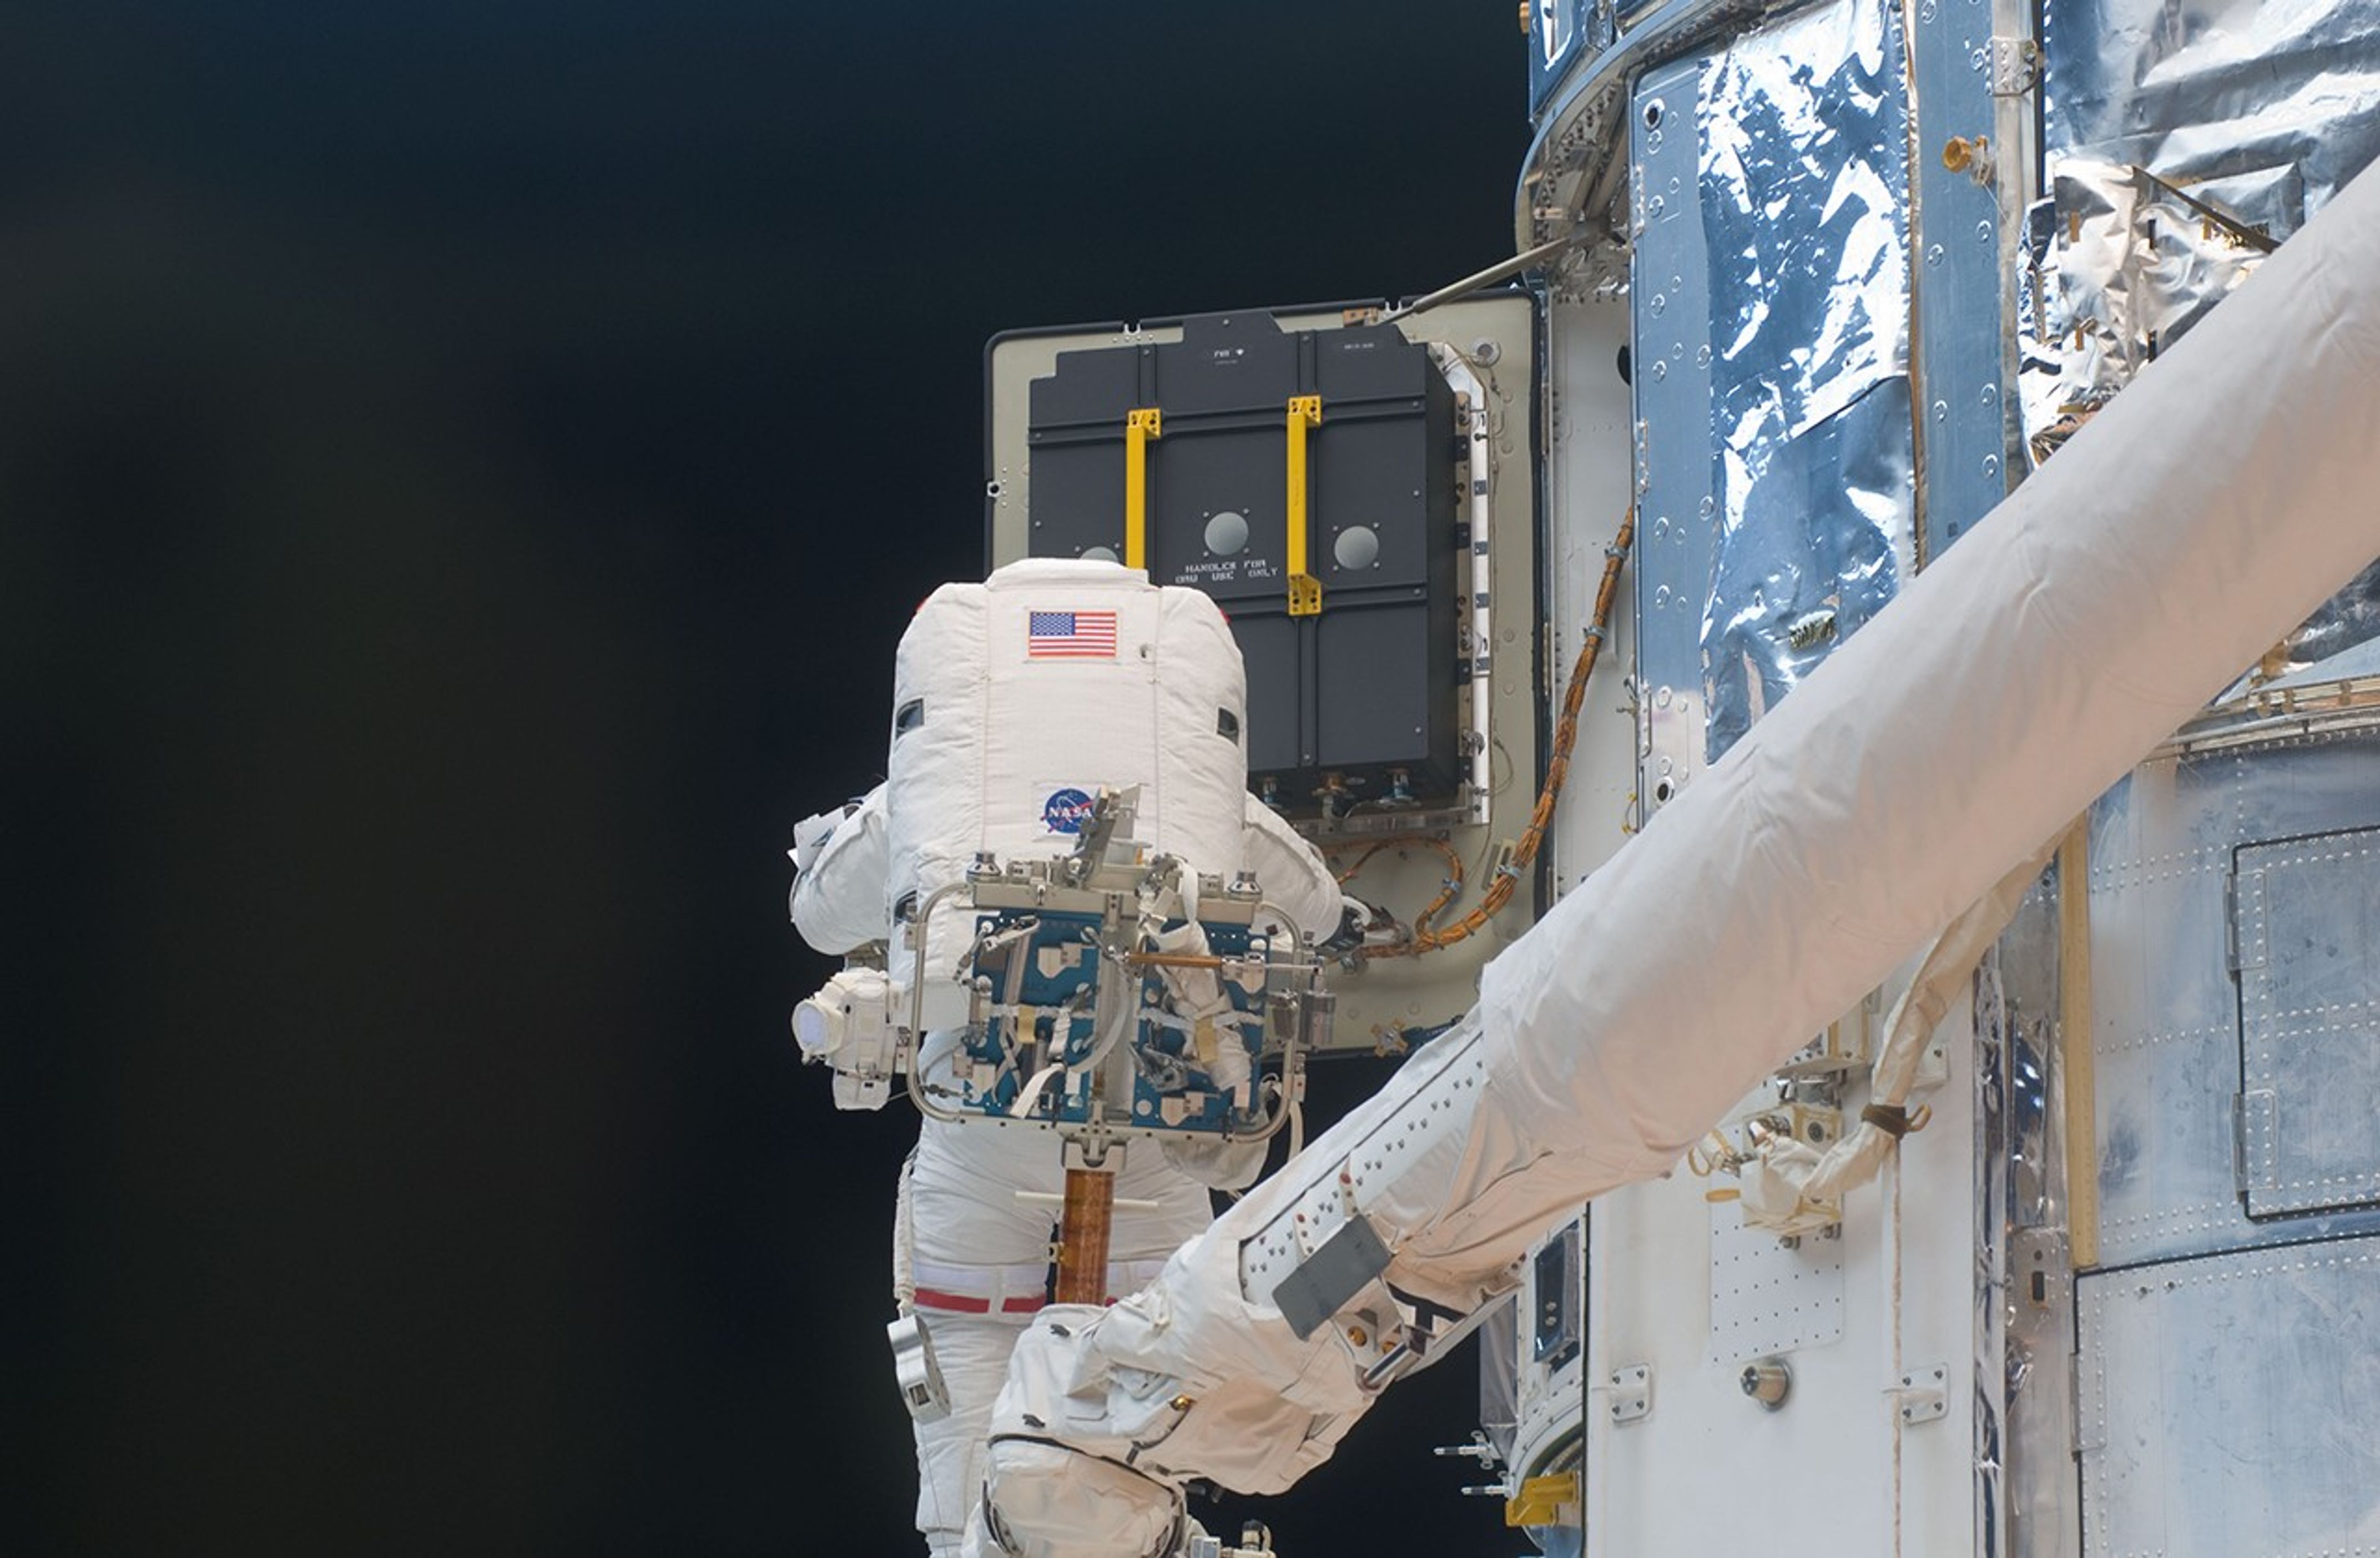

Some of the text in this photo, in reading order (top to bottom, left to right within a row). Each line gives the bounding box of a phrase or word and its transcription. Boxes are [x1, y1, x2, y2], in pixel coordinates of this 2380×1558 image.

[1244, 559, 1265, 568] FOR
[1212, 571, 1234, 581] USE
[1248, 567, 1278, 578] ONLY
[1048, 806, 1092, 818] NASA
